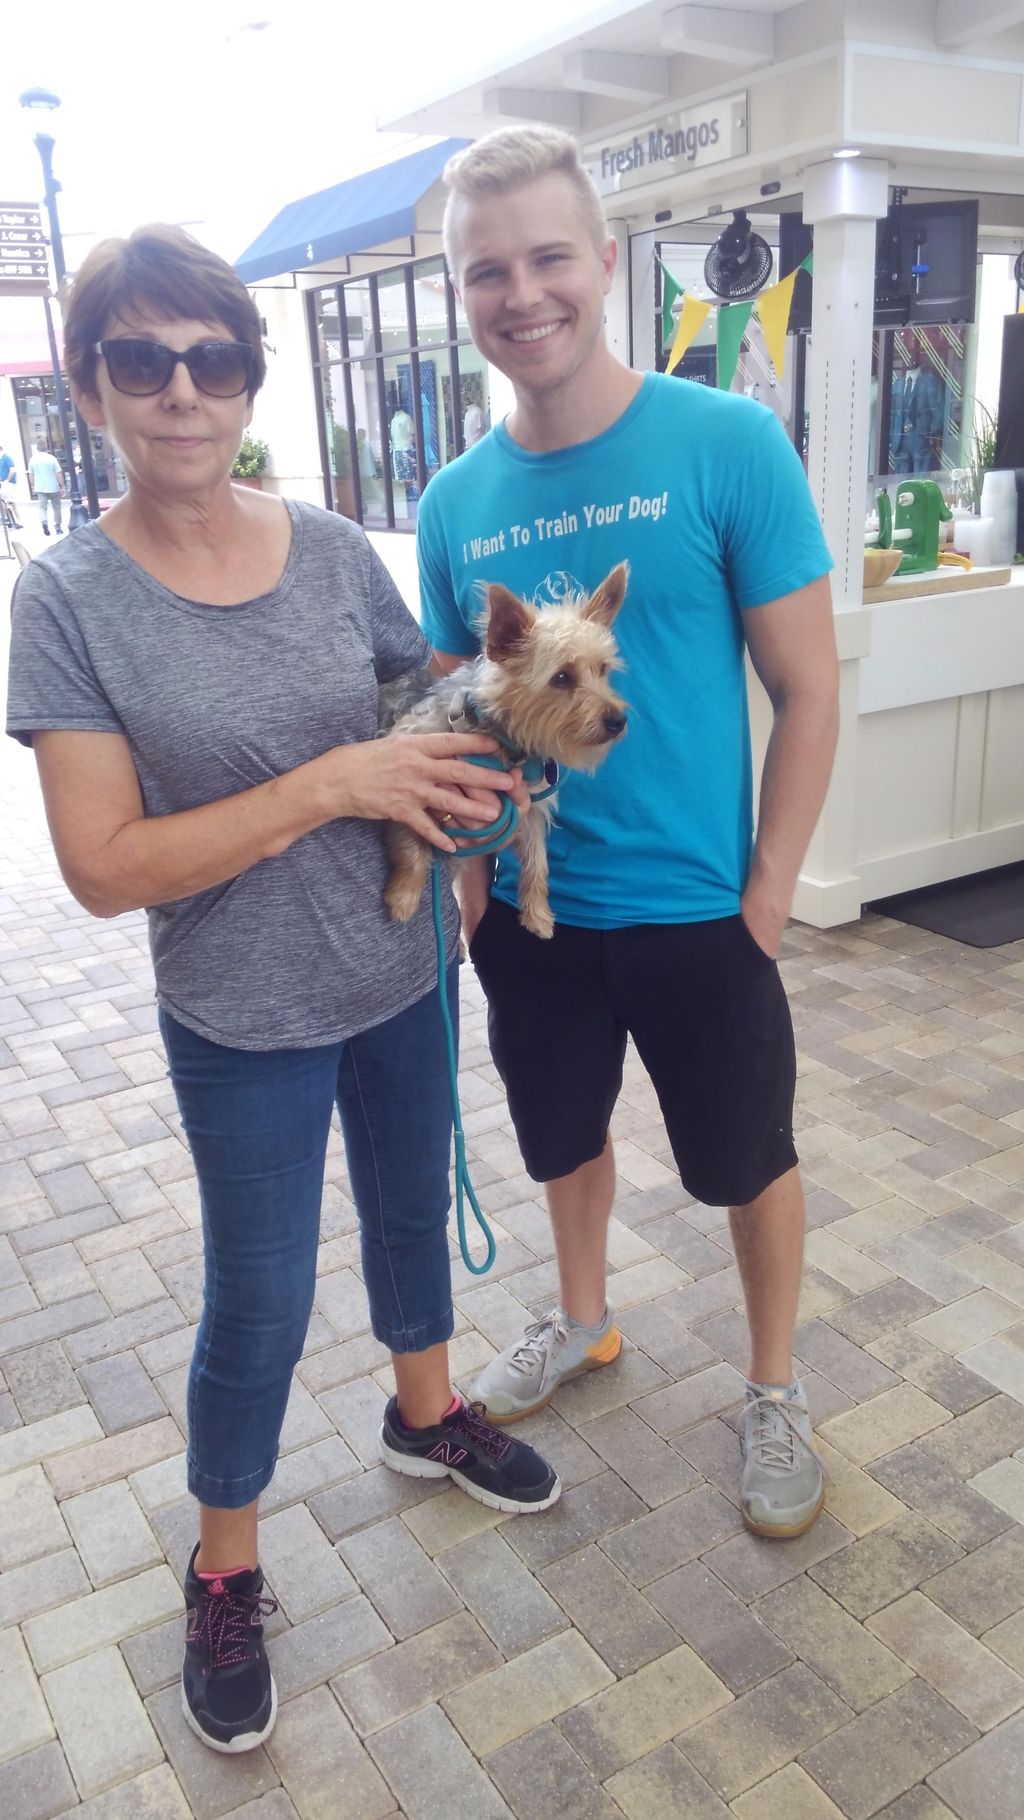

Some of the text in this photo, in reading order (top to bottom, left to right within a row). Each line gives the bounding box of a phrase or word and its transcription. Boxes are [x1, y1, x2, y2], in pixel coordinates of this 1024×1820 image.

[602, 118, 720, 179] Fresh Mangos
[463, 491, 669, 564] I Want To Train Your Dog!
